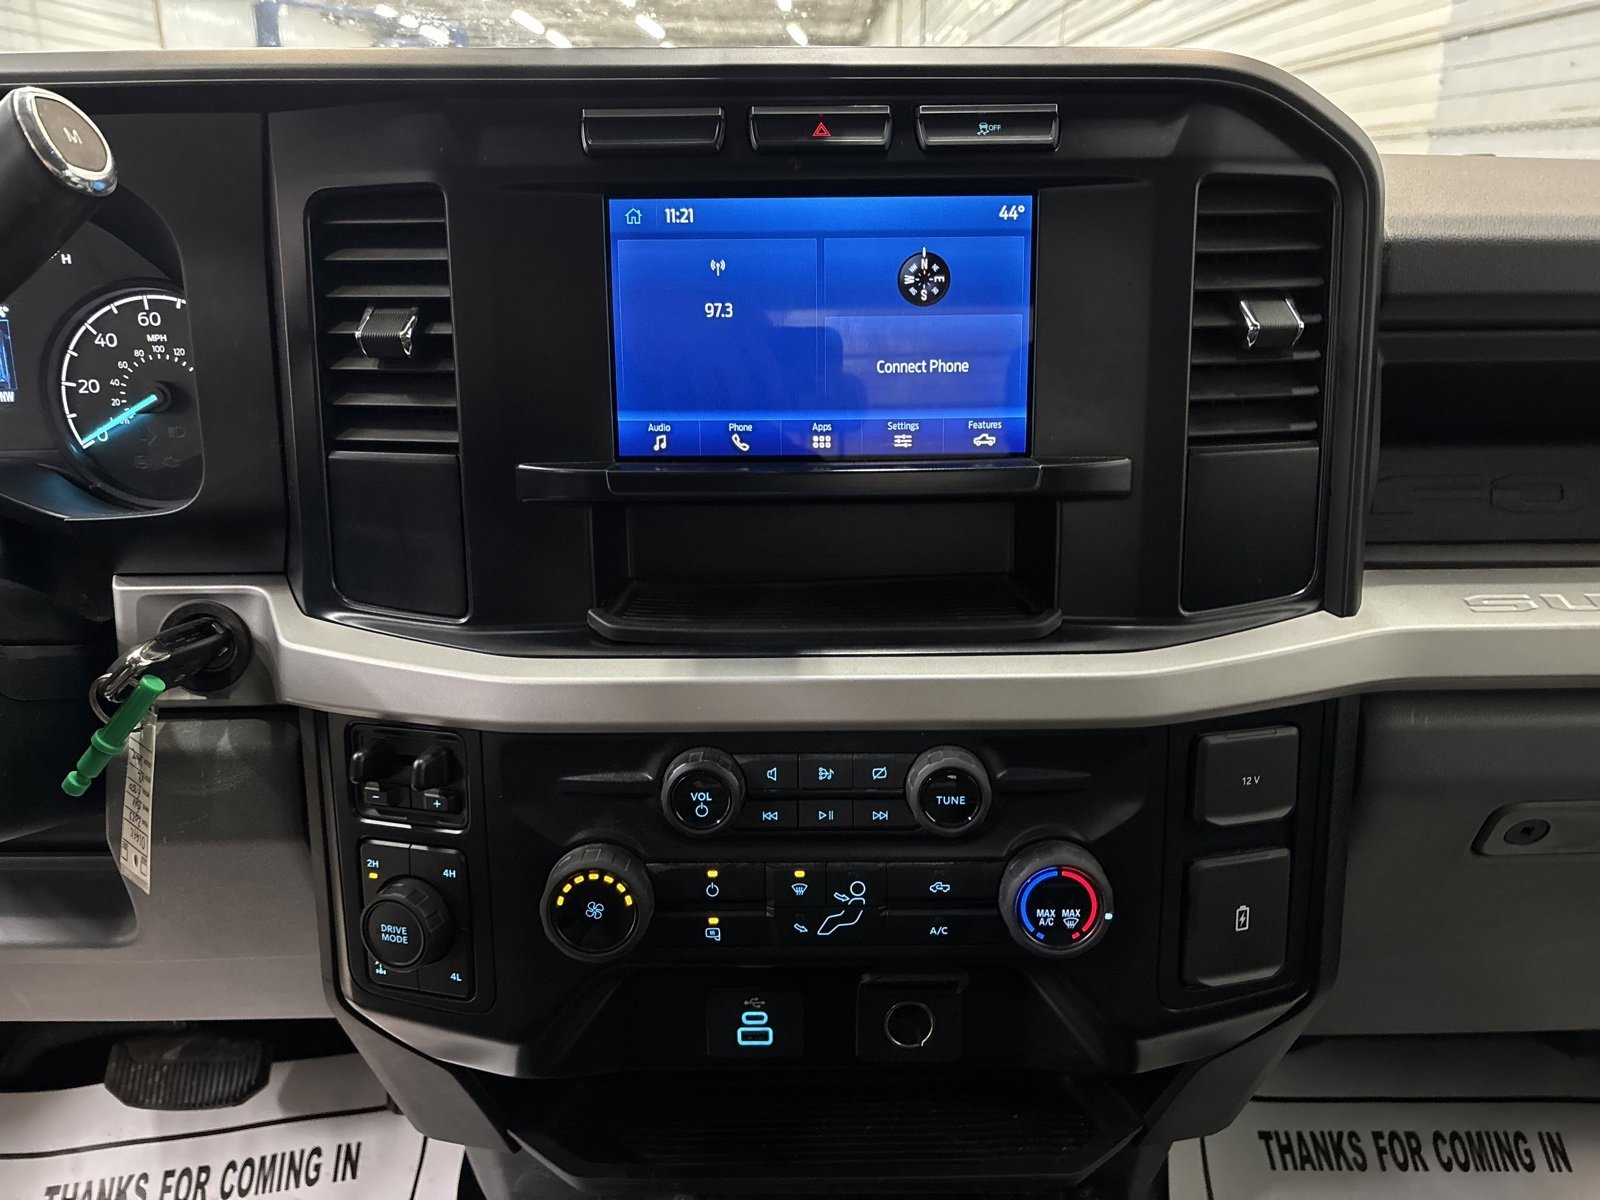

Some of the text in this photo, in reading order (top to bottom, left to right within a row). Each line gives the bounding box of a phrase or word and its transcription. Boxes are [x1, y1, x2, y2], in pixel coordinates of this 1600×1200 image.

[63, 127, 82, 144] M
[664, 207, 694, 223] 11:21
[998, 205, 1026, 220] 44°
[60, 253, 72, 265] H
[920, 258, 928, 270] N
[920, 289, 928, 301] S
[704, 302, 734, 318] 97.3
[137, 312, 161, 326] 60
[94, 333, 118, 347] 40
[146, 334, 168, 342] MPH
[133, 349, 145, 358] 80
[151, 345, 166, 353] 100
[172, 347, 186, 356] 120
[117, 360, 129, 369] 60
[876, 358, 970, 374] Connect Phone
[77, 379, 101, 394] 20
[109, 378, 121, 387] 40
[111, 398, 121, 407] 20
[648, 423, 671, 432] Audio
[728, 422, 753, 432] Phone
[812, 422, 833, 434] Apps
[887, 421, 920, 432] Settings
[967, 419, 1003, 430] Features
[1242, 776, 1252, 785] 12
[690, 792, 713, 802] VOL
[936, 796, 966, 805] TUNE
[366, 859, 379, 868] 2H
[442, 868, 456, 878] 4H
[1036, 909, 1056, 918] MAX
[1061, 909, 1081, 918] MAX
[1038, 917, 1054, 926] A/C
[380, 924, 408, 935] DRIVE
[929, 926, 948, 936] A/C
[381, 934, 408, 944] MODE
[450, 972, 462, 982] 4L
[1258, 1129, 1574, 1173] THANKS FOR COMING IN
[161, 1165, 211, 1200] FOR
[220, 1146, 322, 1200] COMING
[332, 1141, 362, 1183] IN
